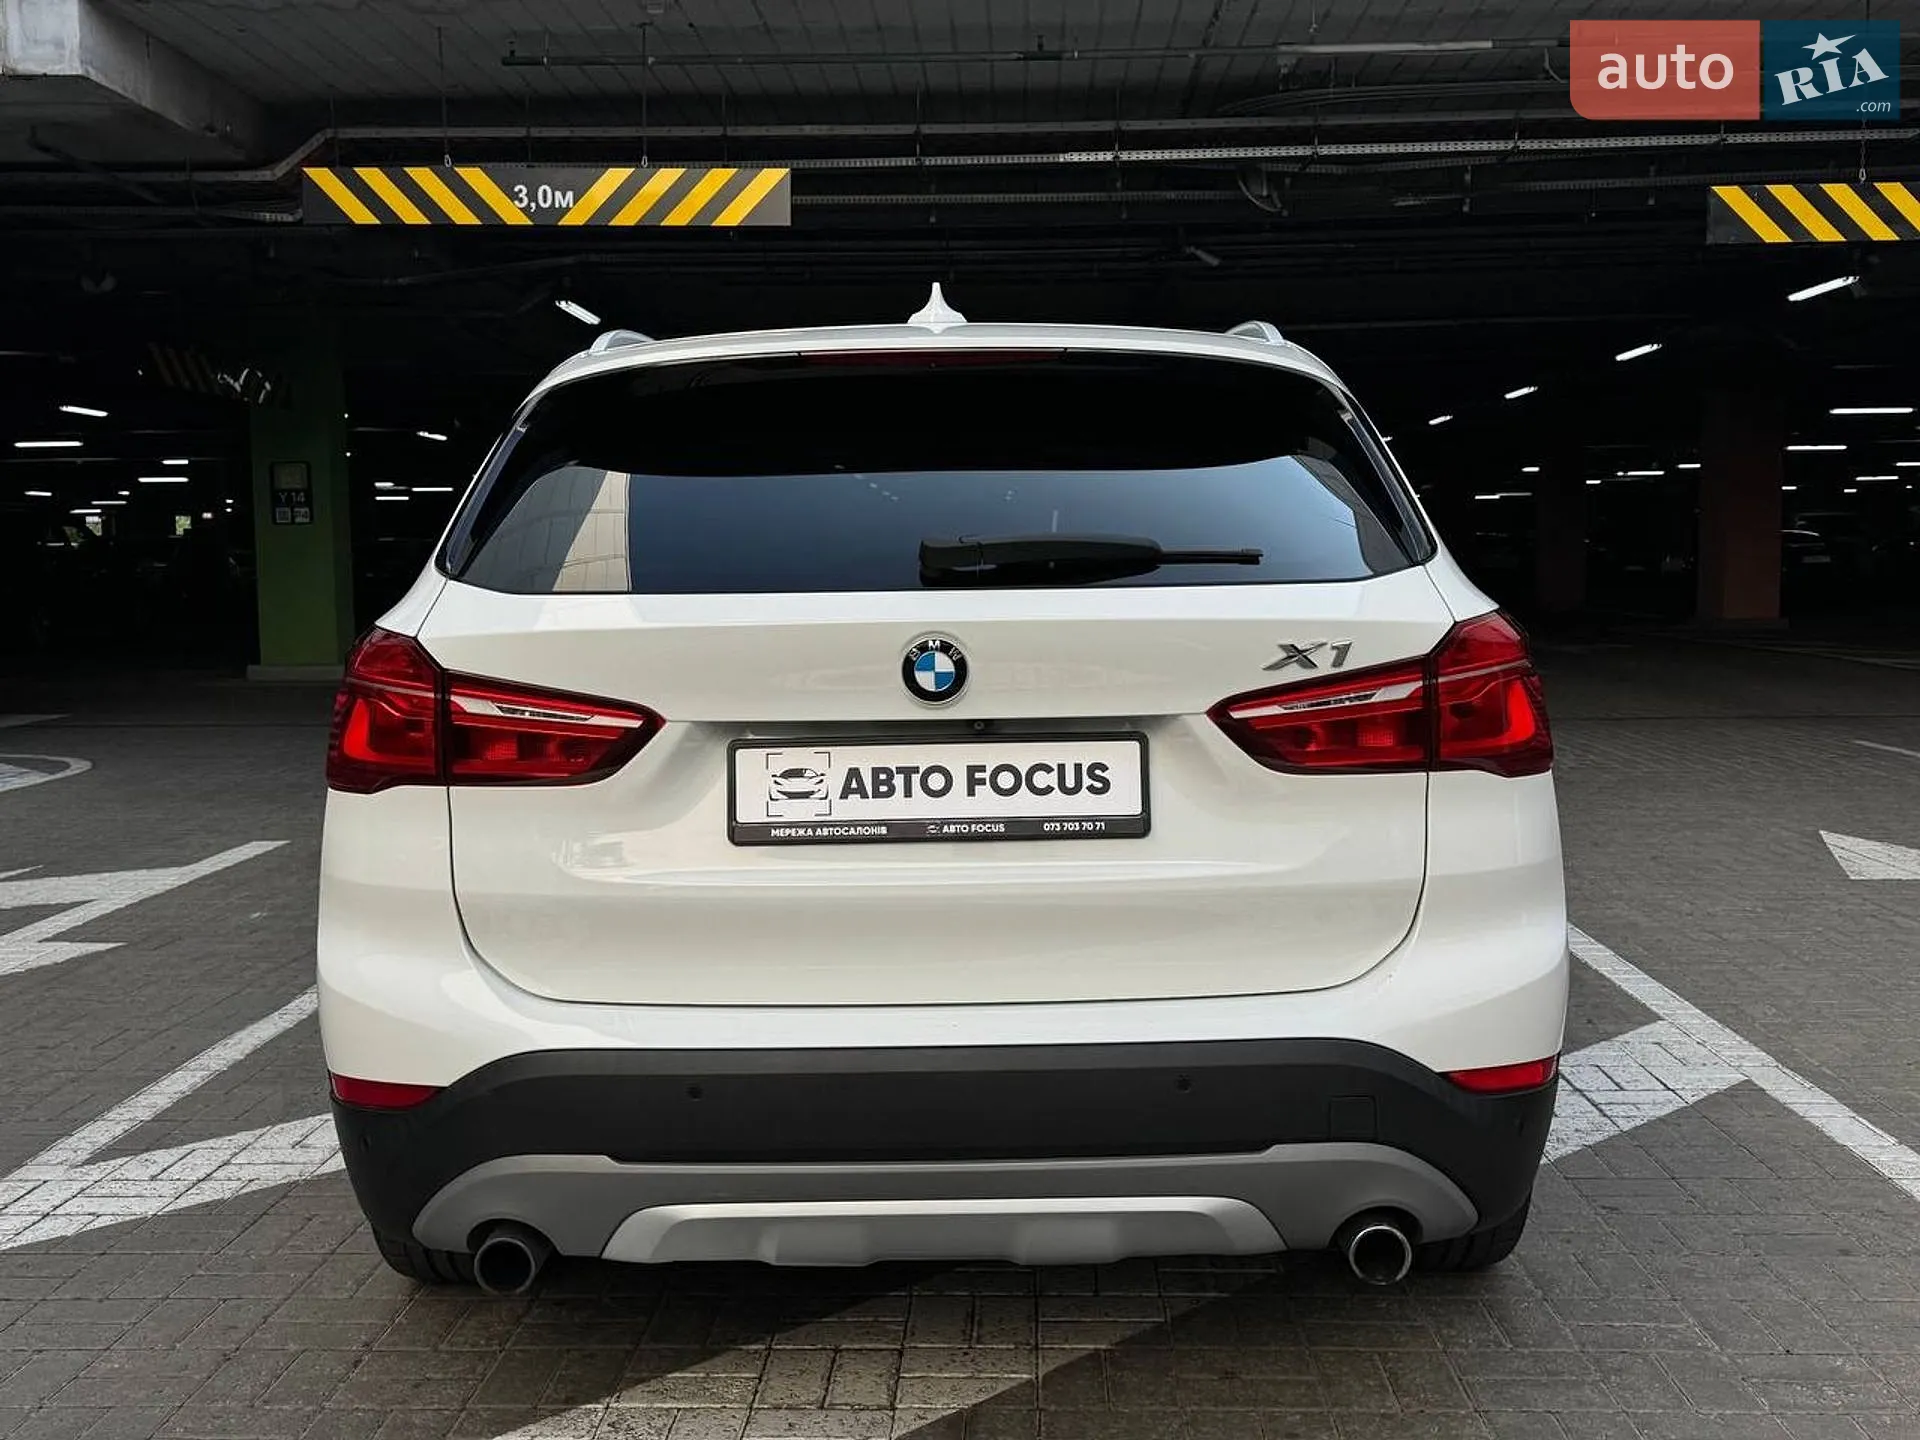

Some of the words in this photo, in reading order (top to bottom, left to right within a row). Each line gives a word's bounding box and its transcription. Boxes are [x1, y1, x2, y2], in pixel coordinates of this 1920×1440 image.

[1262, 640, 1352, 671] X1
[839, 764, 953, 800] АВТО
[966, 762, 1112, 798] FOCUS
[971, 823, 1005, 833] FOCUS
[1043, 822, 1060, 831] 073
[1063, 822, 1080, 831] 703
[1081, 822, 1094, 831] 70
[1094, 821, 1106, 830] 71
[770, 827, 814, 838] МЕРЕЖА
